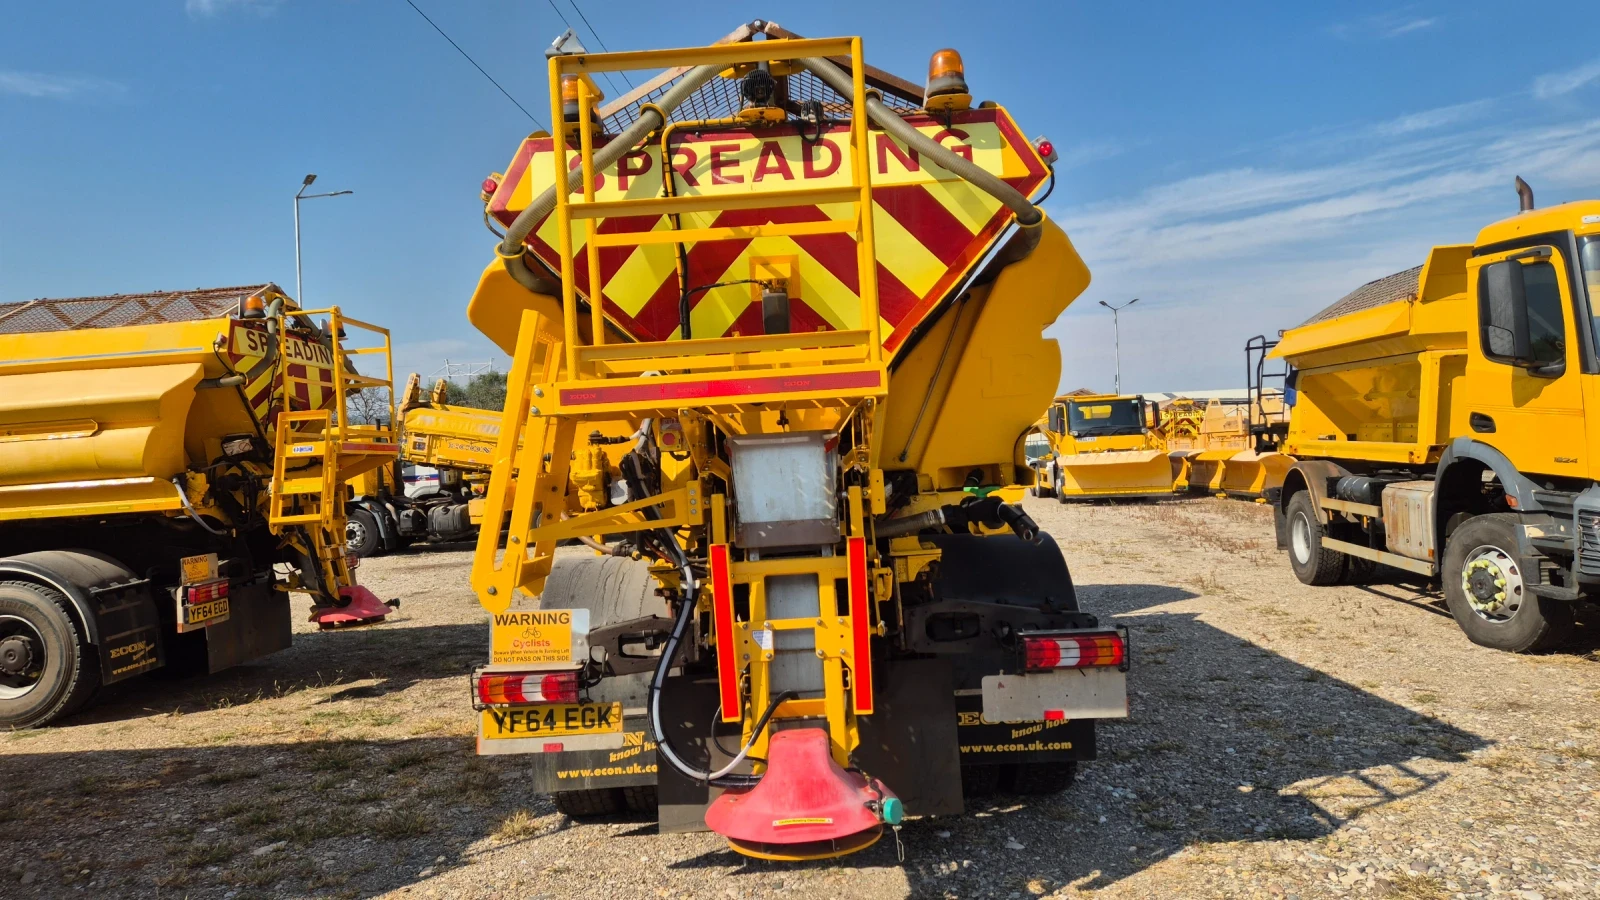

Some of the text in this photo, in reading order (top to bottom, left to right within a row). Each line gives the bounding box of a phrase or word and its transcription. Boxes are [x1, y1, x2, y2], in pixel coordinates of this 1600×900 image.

[190, 605, 213, 621] YF64
[494, 612, 570, 626] WARNING
[513, 639, 551, 649] Cyclists
[494, 701, 611, 734] YF64 EGK
[1011, 724, 1043, 739] know
[609, 745, 641, 763] know
[960, 740, 1073, 753] www.econ.uk.com
